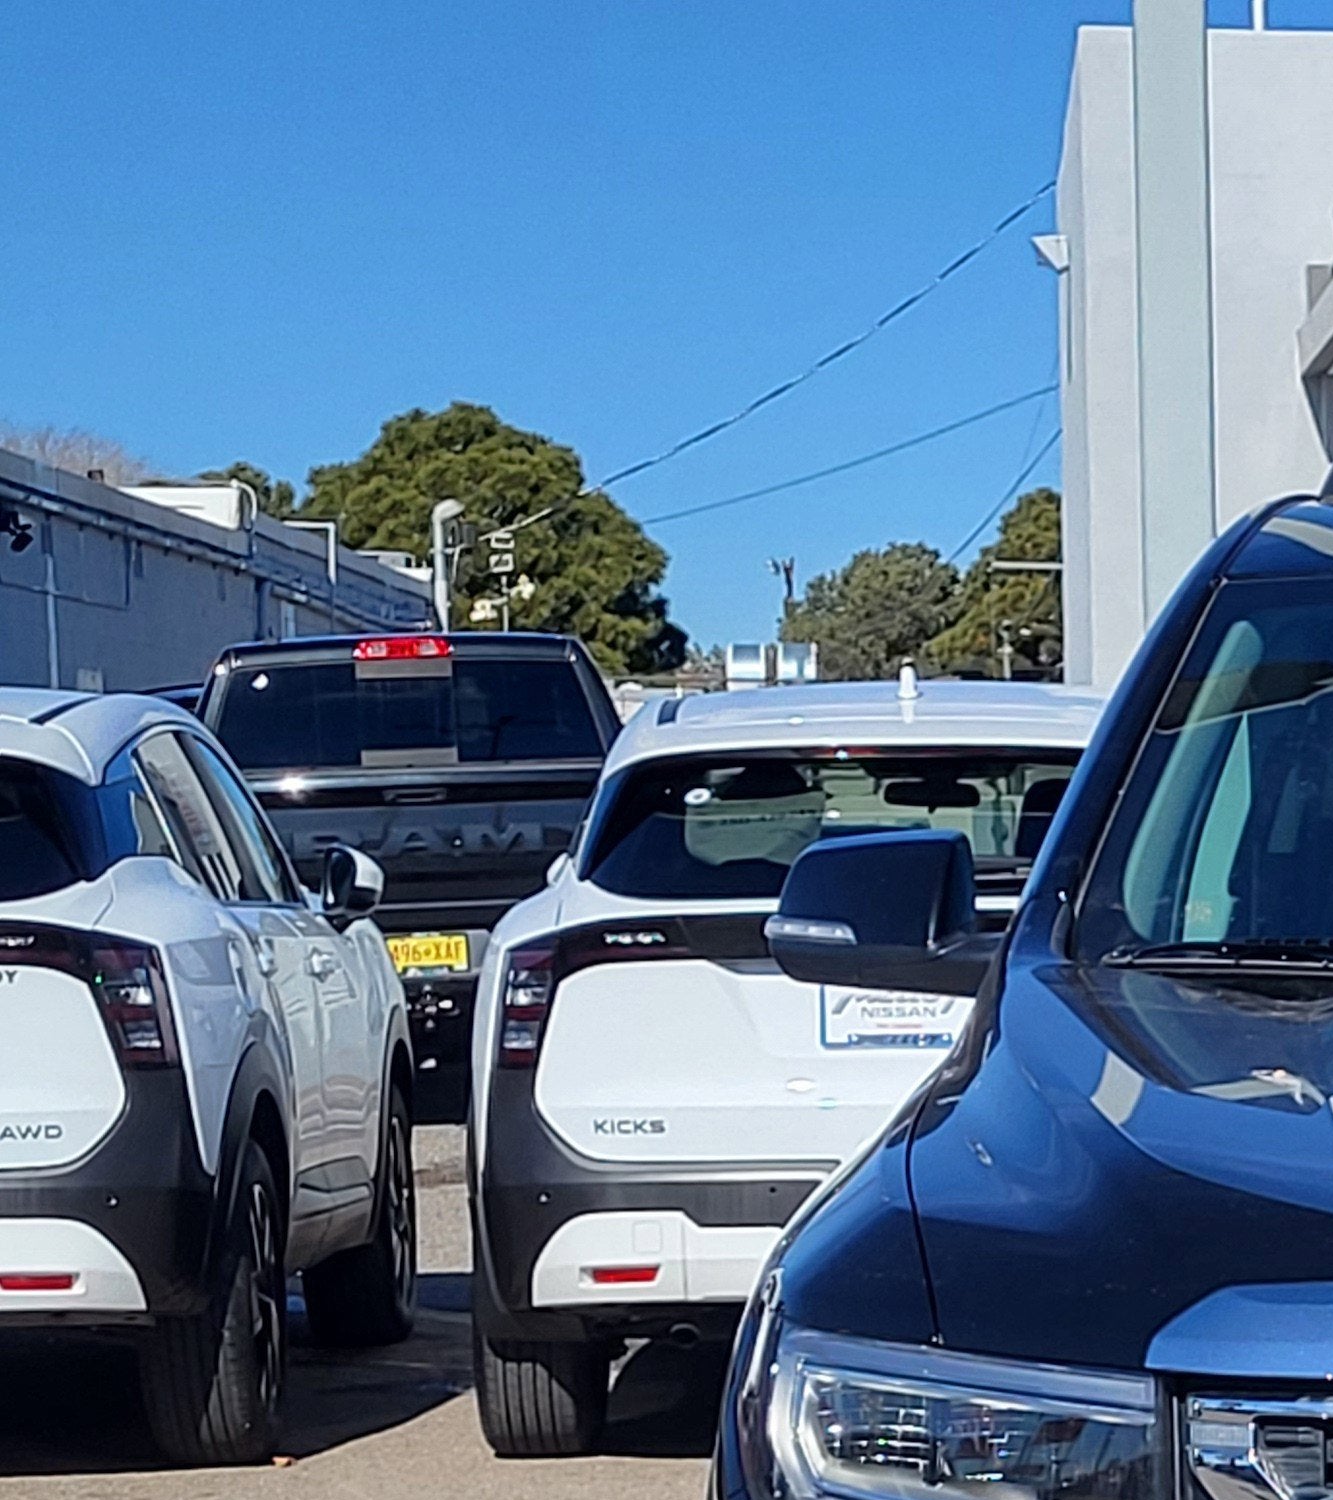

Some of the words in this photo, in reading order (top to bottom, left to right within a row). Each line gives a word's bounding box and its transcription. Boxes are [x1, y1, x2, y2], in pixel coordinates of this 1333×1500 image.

[293, 824, 543, 856] RAM
[861, 1006, 937, 1018] NISSAN
[0, 1125, 63, 1140] AWD
[593, 1119, 666, 1134] KICKS
